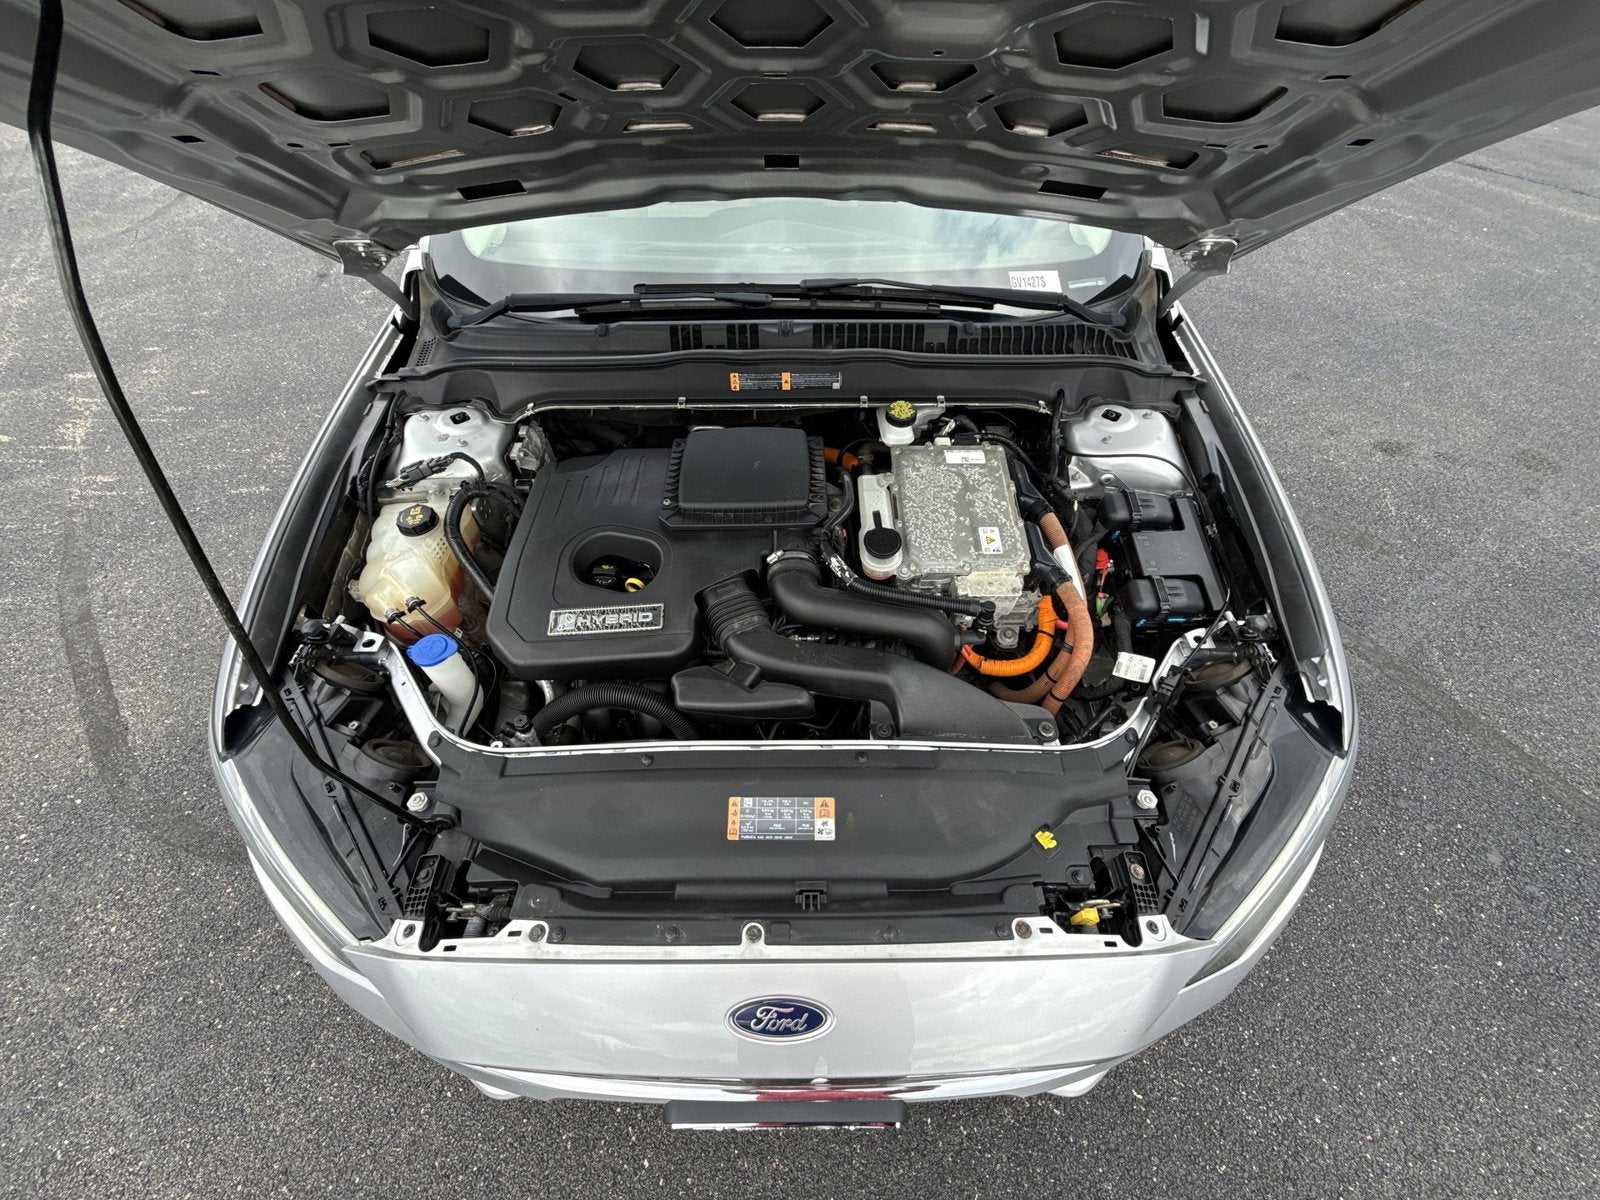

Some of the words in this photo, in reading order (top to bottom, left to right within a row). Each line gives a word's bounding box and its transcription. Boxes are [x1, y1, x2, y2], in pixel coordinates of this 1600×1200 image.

[1011, 276, 1047, 288] GV1427S
[577, 612, 653, 626] HYBRID
[750, 1006, 809, 1032] Ford
